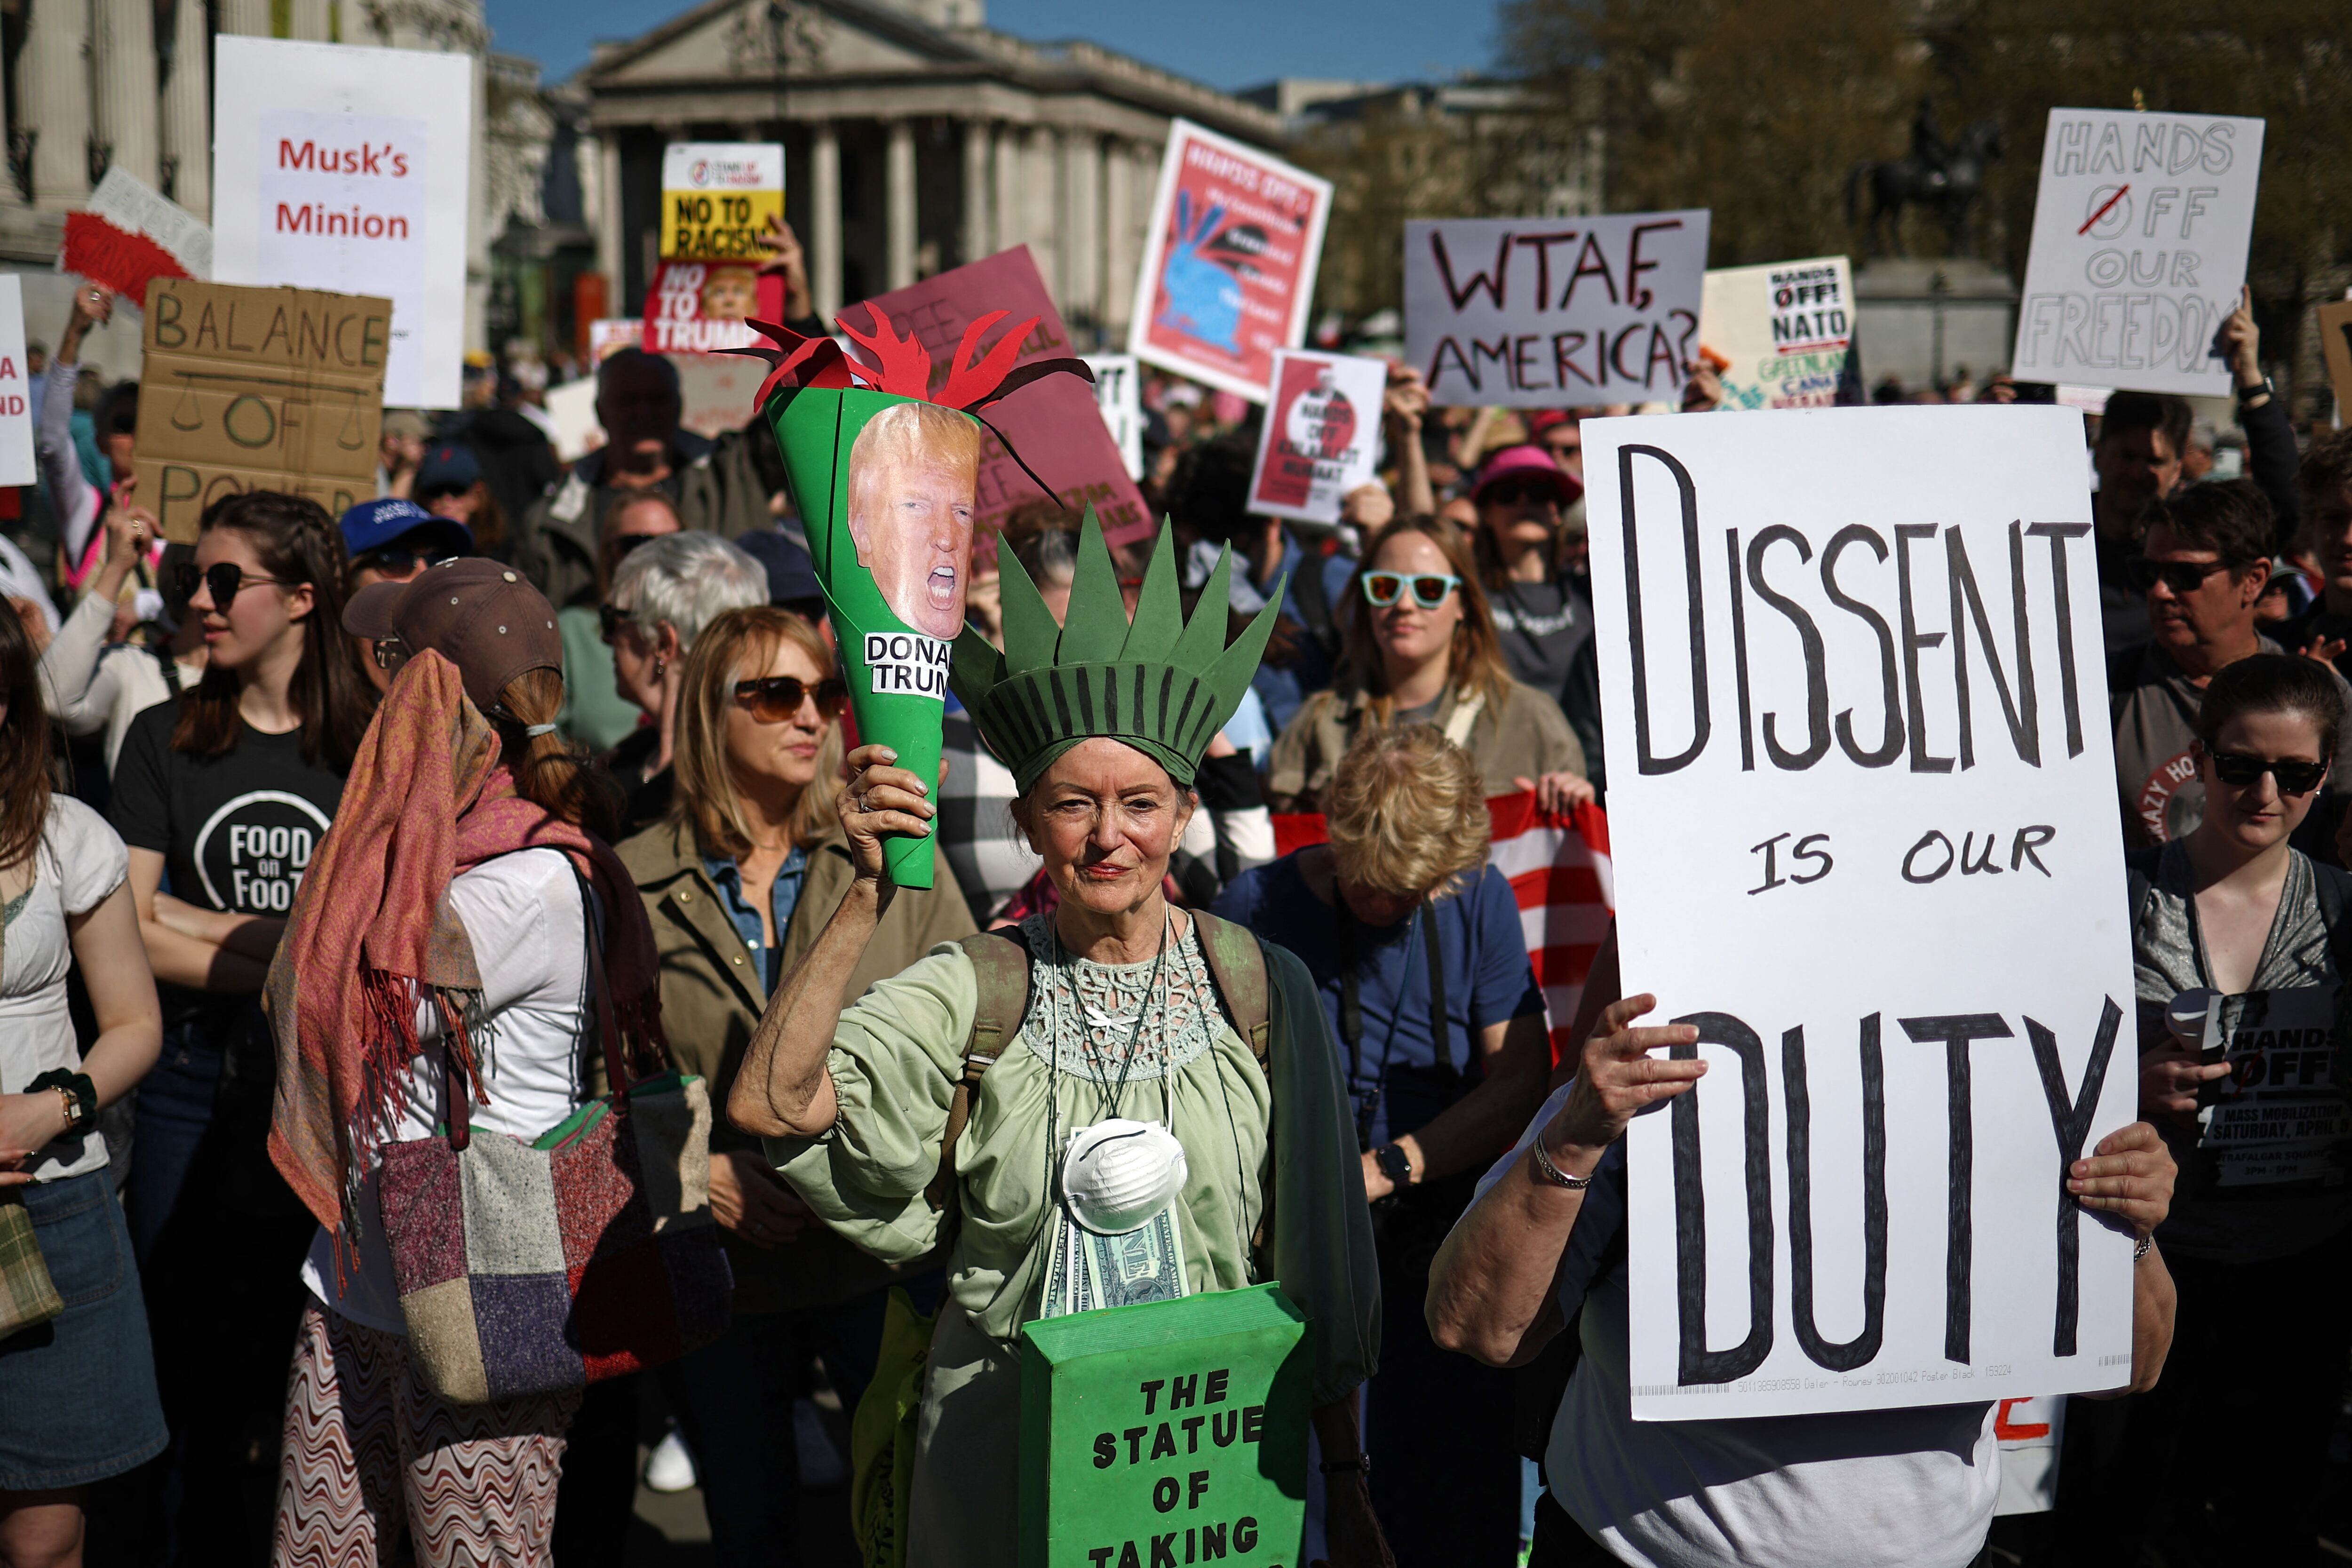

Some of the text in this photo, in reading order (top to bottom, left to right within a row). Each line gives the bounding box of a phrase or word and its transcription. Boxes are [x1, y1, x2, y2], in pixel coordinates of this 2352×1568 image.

[278, 139, 409, 176] Musk's
[2054, 122, 2236, 176] HANDS
[276, 204, 409, 240] Minion
[677, 196, 750, 224] NO TO
[662, 264, 704, 289] NO
[1430, 220, 1683, 311] WTAF,
[1772, 268, 1836, 283] HANDS
[2086, 249, 2201, 288] OUR
[658, 290, 698, 318] TO
[156, 293, 382, 368] BALANCE
[653, 319, 761, 351] TRUMP
[1772, 310, 1847, 341] NATO
[1425, 309, 1699, 392] AMERICA?
[224, 394, 312, 449] OF
[1618, 443, 2091, 775] DISSENT
[868, 636, 948, 670] DONA
[230, 824, 312, 868] FOOD
[1748, 825, 2055, 894] IS OUR
[258, 859, 280, 877] on
[2214, 1122, 2290, 1139] SATURDAY,
[2296, 1121, 2335, 1137] APRIL
[2225, 1105, 2342, 1122] MASS MOBILIZATION
[2221, 1152, 2281, 1162] TRAFALGAR
[2245, 1166, 2265, 1175] 3PM
[1669, 994, 2123, 1386] DUTY
[1140, 1369, 1229, 1415] THE
[1804, 1378, 1828, 1389] Daler
[1843, 1376, 1872, 1388] Rowney
[1921, 1370, 1948, 1382] Poster
[1953, 1368, 1975, 1379] Black
[1093, 1406, 1263, 1469] STATUE
[1153, 1470, 1209, 1513] OF
[1089, 1516, 1259, 1568] TAKING
